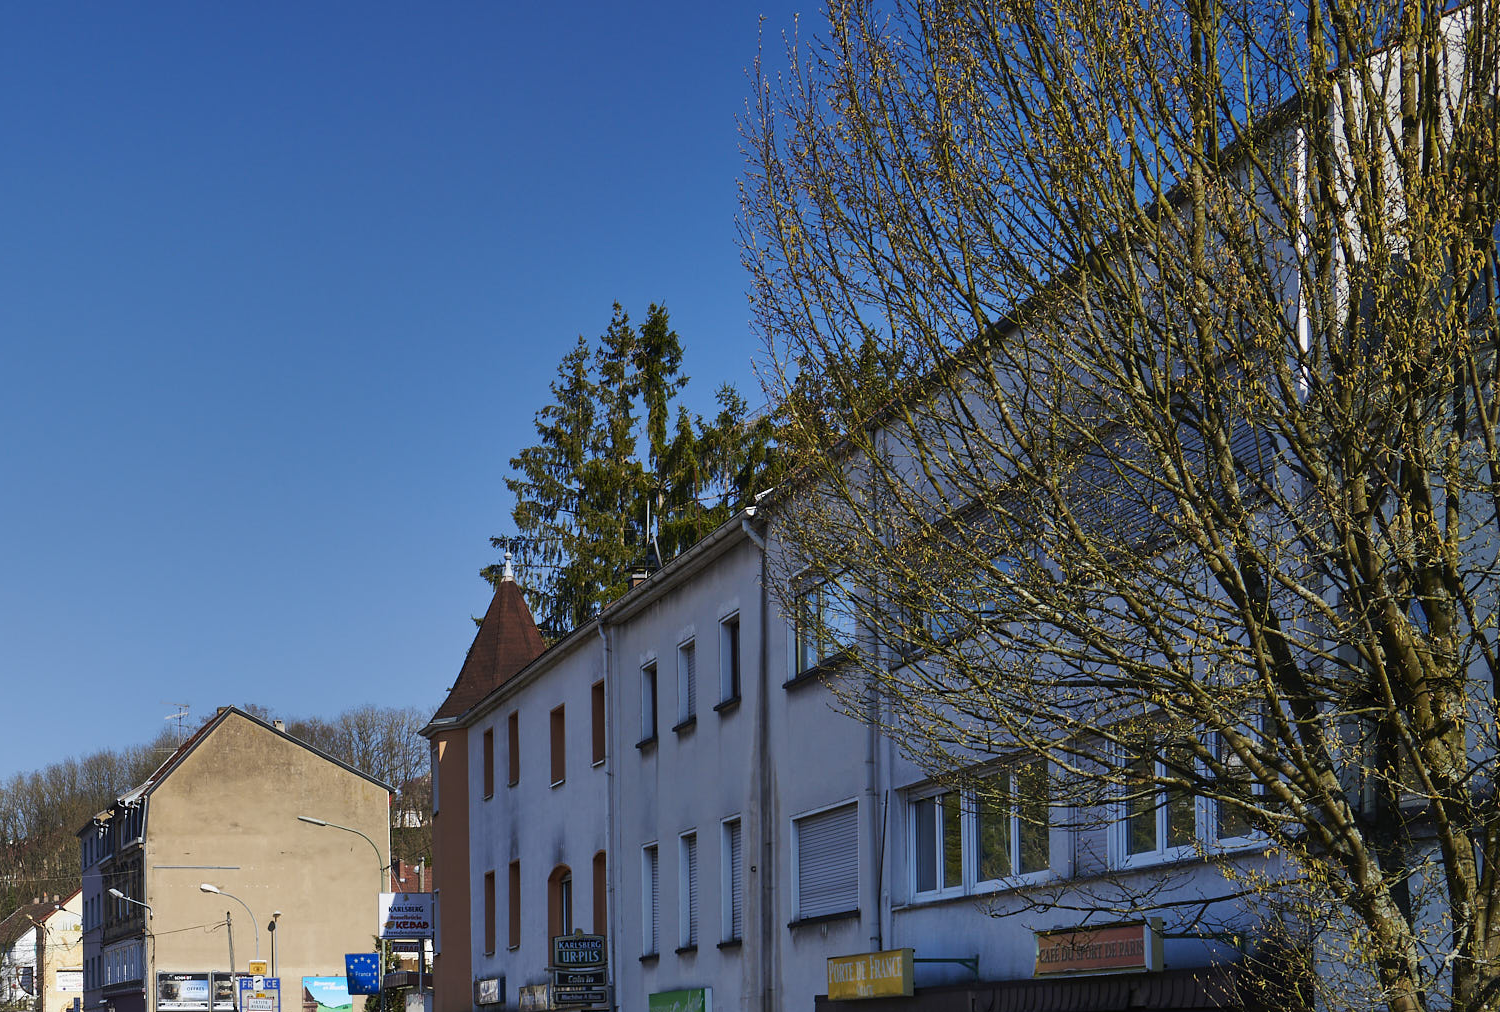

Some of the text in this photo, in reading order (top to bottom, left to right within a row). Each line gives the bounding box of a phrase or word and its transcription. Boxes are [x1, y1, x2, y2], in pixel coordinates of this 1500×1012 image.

[558, 940, 602, 949] KARLSBERG
[1105, 941, 1117, 959] DE
[828, 955, 902, 984] PORTE DE FRANCE
[242, 980, 277, 989] FRCE
